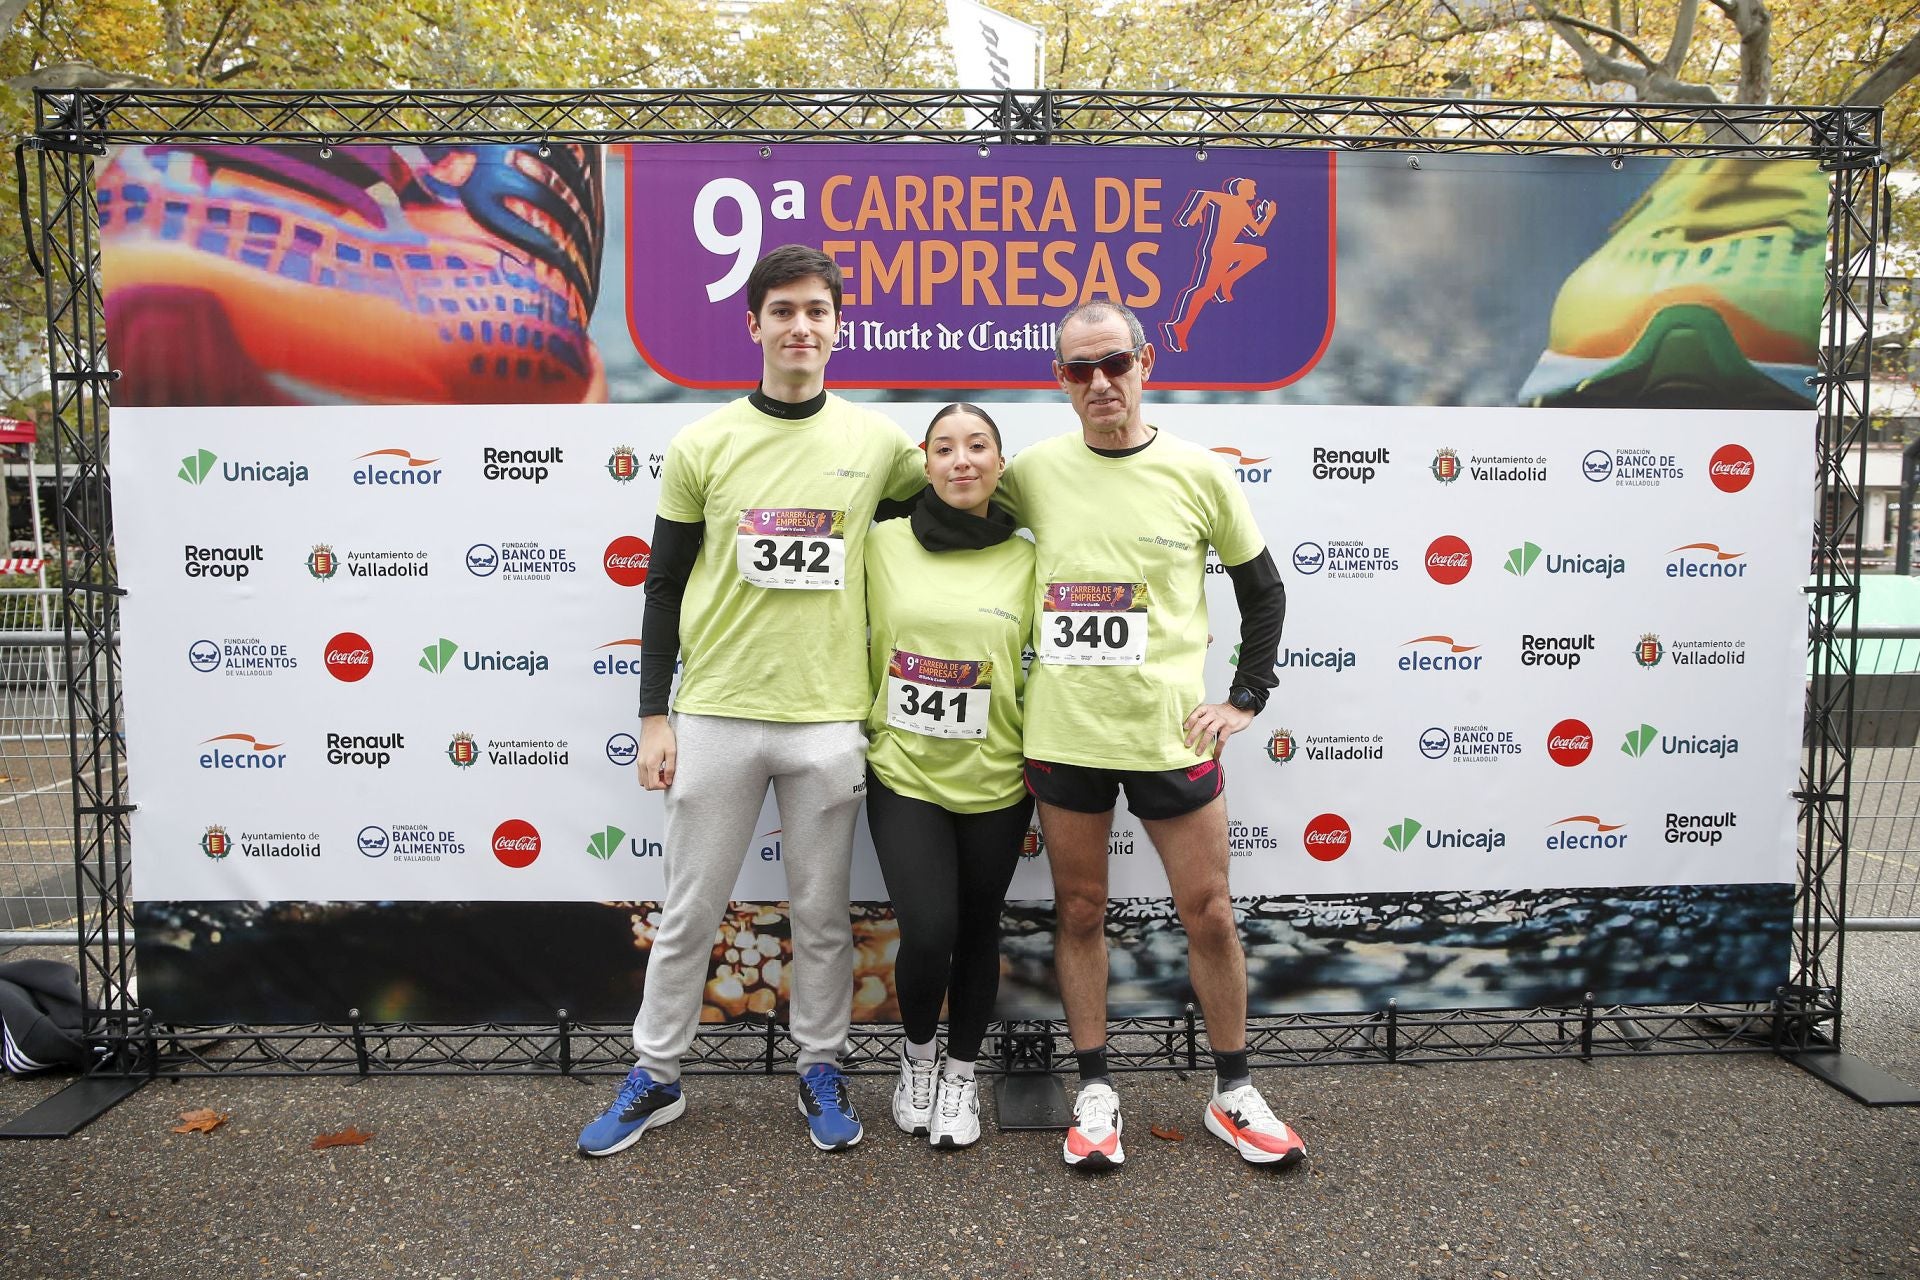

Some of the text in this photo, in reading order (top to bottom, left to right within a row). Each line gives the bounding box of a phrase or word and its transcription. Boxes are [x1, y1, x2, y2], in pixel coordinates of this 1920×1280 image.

[820, 175, 1077, 233] CARRERA
[1095, 177, 1163, 233] DE
[823, 240, 1161, 309] EMPRESAS
[859, 320, 932, 351] Norte
[936, 322, 964, 351] de
[967, 320, 1057, 351] Castill
[484, 447, 563, 463] Renault
[1314, 447, 1390, 464] Renault
[1617, 448, 1650, 456] FUNDACIÓN
[1471, 456, 1547, 465] Ayuntamiento de
[1616, 456, 1675, 466] BANCO DE
[223, 461, 308, 487] Unicaja
[484, 464, 548, 484] Group
[1313, 464, 1375, 484] Group
[1471, 467, 1546, 481] Valladolid
[1616, 468, 1683, 478] ALIMENTOS
[1711, 460, 1752, 476] Coca-Cola
[353, 466, 442, 486] elecnor
[776, 511, 807, 519] CARRERA
[775, 518, 815, 527] EMPRESAS
[502, 540, 538, 549] FUNDACIÓN
[1328, 539, 1363, 547] FUNDACIÓN
[185, 545, 263, 561] Renault
[348, 551, 427, 561] Ayuntamiento de
[502, 549, 566, 560] BANCO DE
[753, 539, 830, 573] 342
[1328, 548, 1389, 558] BANCO DE
[1428, 552, 1471, 567] Coca-Cola
[503, 562, 576, 574] ALIMENTOS
[607, 553, 650, 569] Coca-Cola
[1328, 560, 1398, 570] ALIMENTOS
[1547, 554, 1625, 579] Unicaja
[1666, 557, 1747, 577] elecnor
[185, 561, 249, 581] Group
[348, 562, 428, 576] Valladolid
[1070, 593, 1112, 602] EMPRESAS
[1053, 615, 1129, 649] 340
[224, 637, 259, 645] FUNDACIÓN
[1522, 634, 1595, 651] Renault
[1672, 640, 1732, 649] Ayuntamiento
[224, 645, 287, 656] BANCO DE
[327, 649, 369, 665] Coca-Cola
[1672, 651, 1744, 664] Valladolid
[226, 658, 297, 668] ALIMENTOS
[464, 651, 548, 676] Unicaja
[919, 658, 949, 670] CARRERA
[1275, 648, 1356, 672] Unicaja
[1399, 649, 1482, 671] elecnor
[1521, 651, 1580, 670] Group
[918, 665, 958, 679] EMPRESAS
[900, 685, 968, 723] 341
[1454, 724, 1488, 732] FUNDACIÓN
[327, 733, 404, 749] Renault
[488, 740, 554, 749] Ayuntamiento
[1306, 734, 1383, 745] Ayuntamiento de
[1454, 732, 1513, 743] BANCO DE
[1550, 735, 1591, 750] Coca-Cola
[1306, 746, 1383, 760] Valladolid
[1453, 744, 1521, 755] ALIMENTOS
[1662, 735, 1738, 759] Unicaja
[200, 749, 286, 768] elecnor
[327, 749, 390, 769] Group
[488, 751, 568, 765] Valladolid
[1666, 812, 1736, 828] Renault
[241, 832, 319, 842] Ayuntamiento de
[393, 831, 455, 842] BANCO DE
[1252, 827, 1269, 837] DE
[1306, 830, 1349, 845] Coca-Cola
[1665, 828, 1722, 846] Group
[494, 836, 538, 851] Coca-Cola
[1228, 839, 1277, 849] MENTOS
[1427, 828, 1505, 852] Unicaja
[1547, 829, 1627, 850] elecnor
[241, 843, 320, 857] Valladolid
[394, 843, 465, 854] ALIMENTOS
